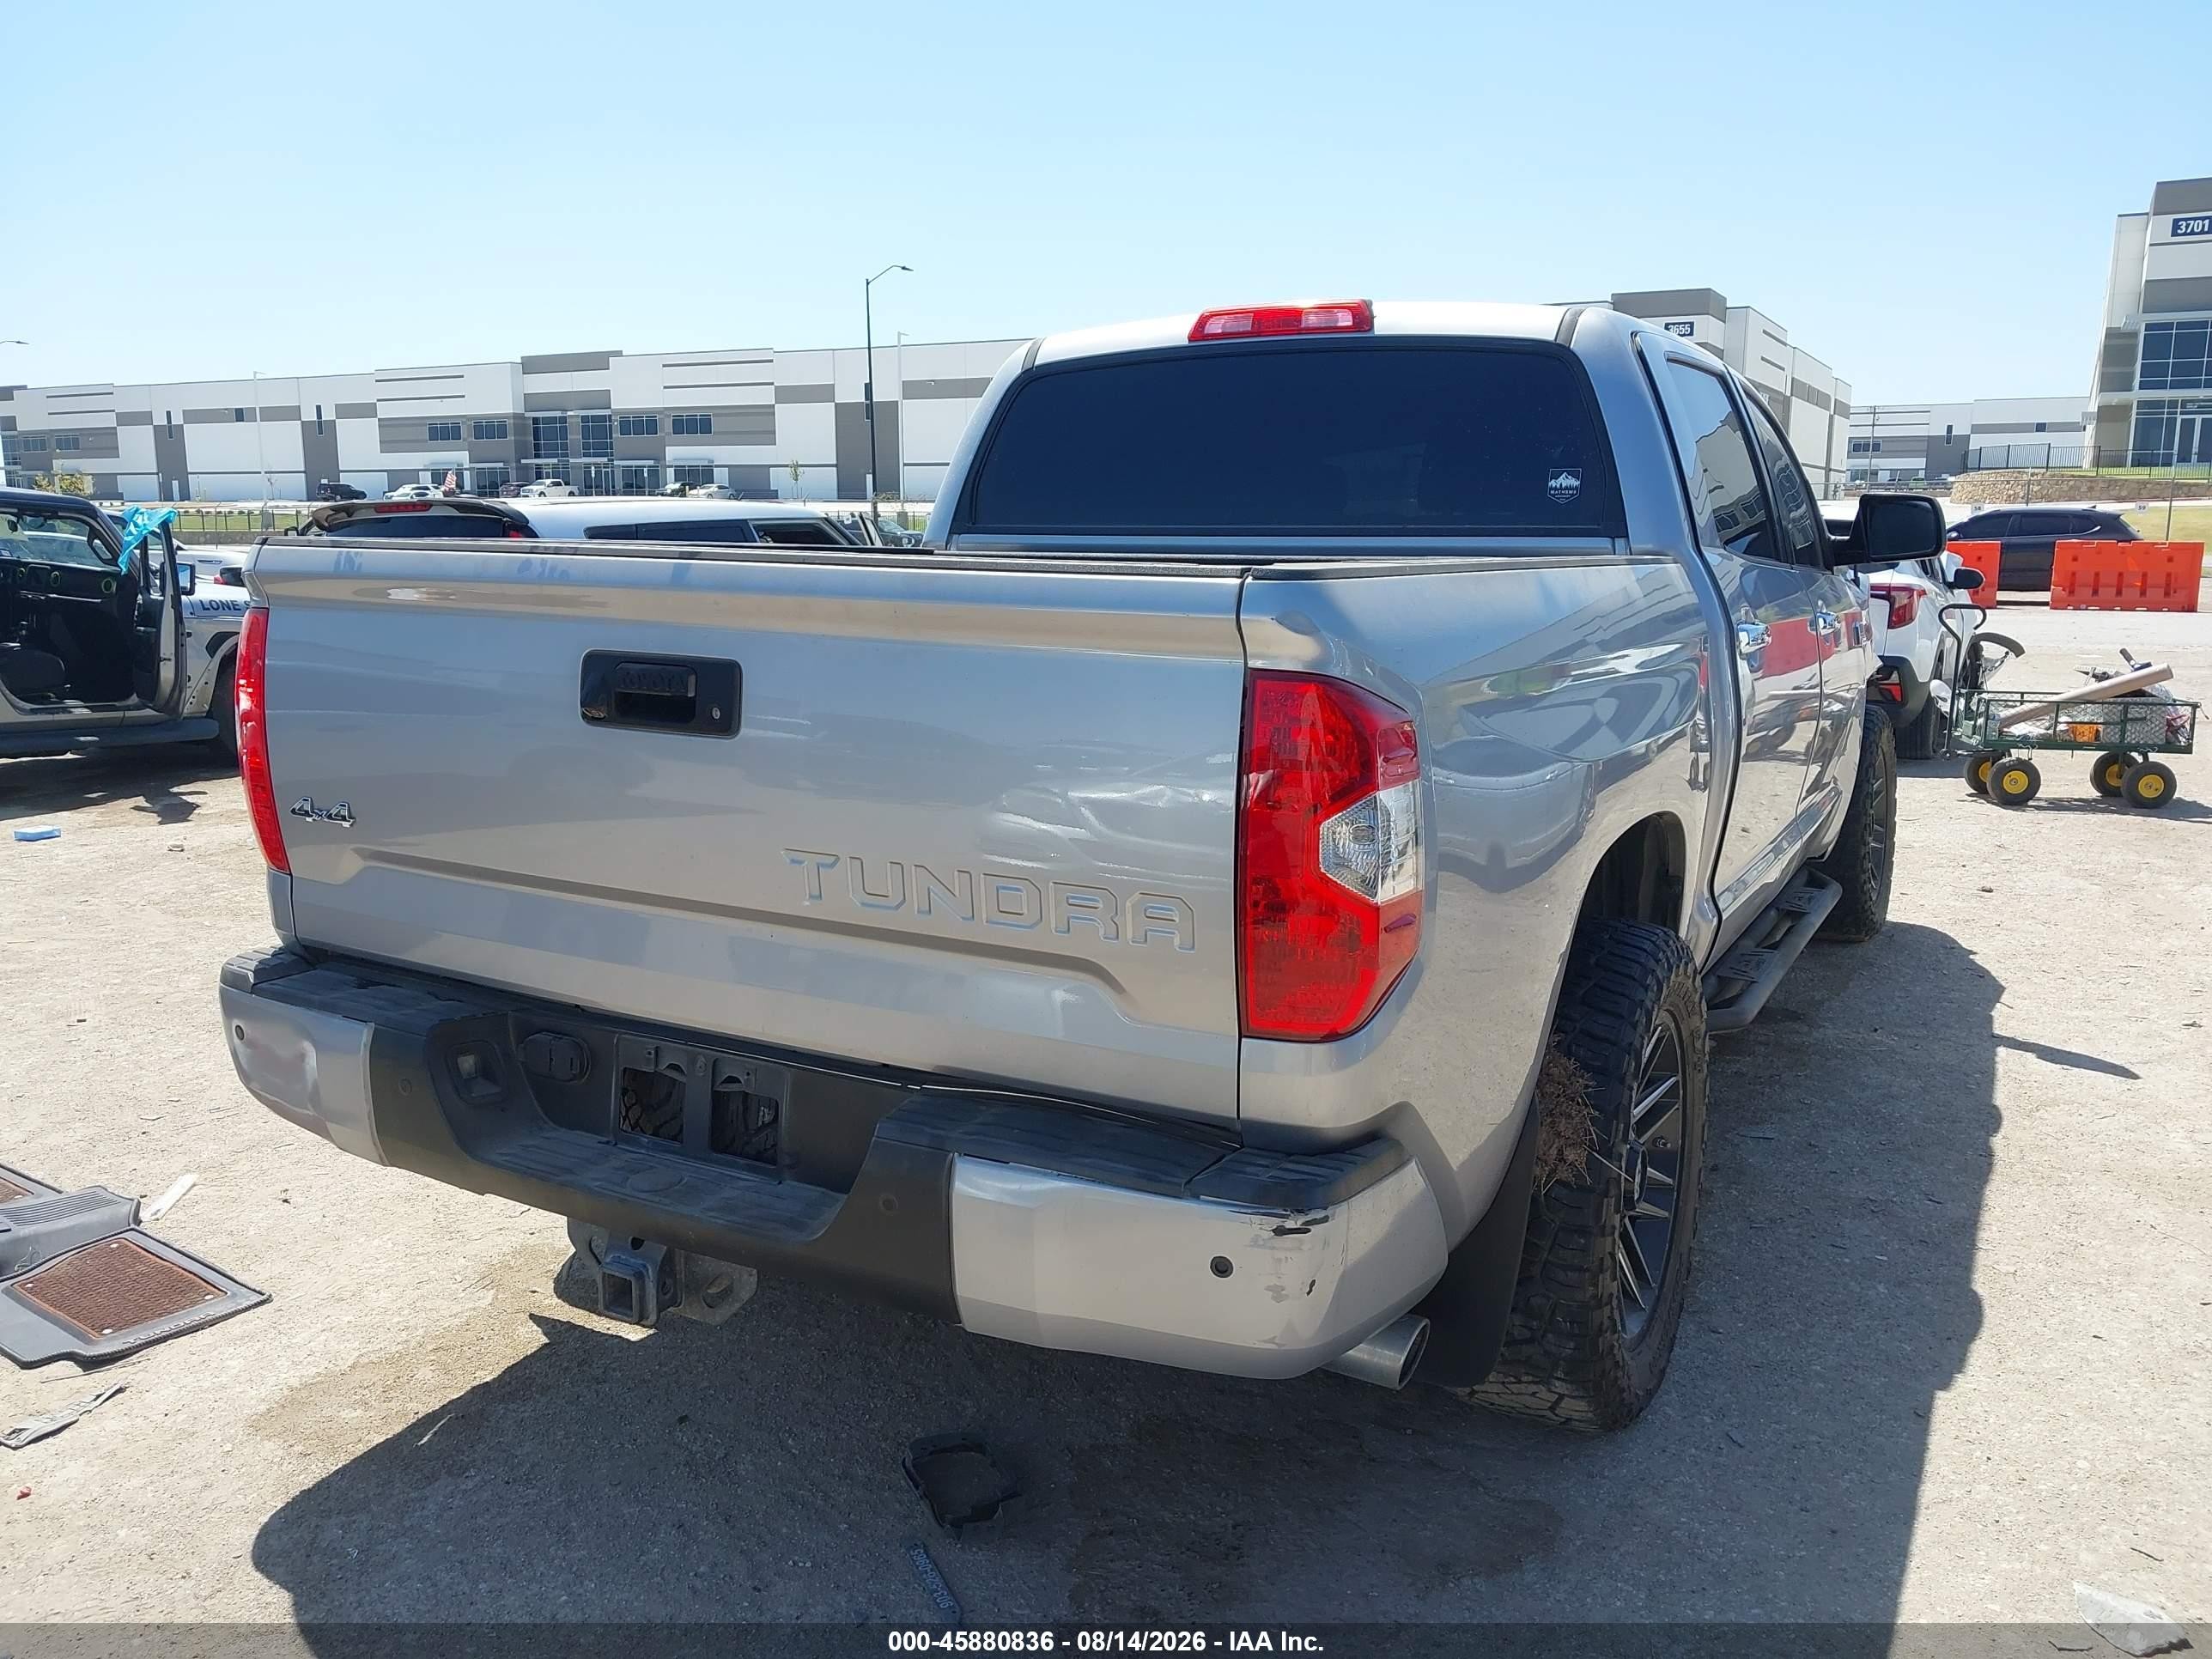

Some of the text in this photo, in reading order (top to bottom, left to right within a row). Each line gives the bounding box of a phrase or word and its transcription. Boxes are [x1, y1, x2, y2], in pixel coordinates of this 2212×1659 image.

[2177, 219, 2210, 234] 3701
[1668, 324, 1691, 335] 3655
[198, 599, 242, 611] LONE
[781, 848, 1198, 953] TUNDRA
[122, 1312, 216, 1345] TUNDRA
